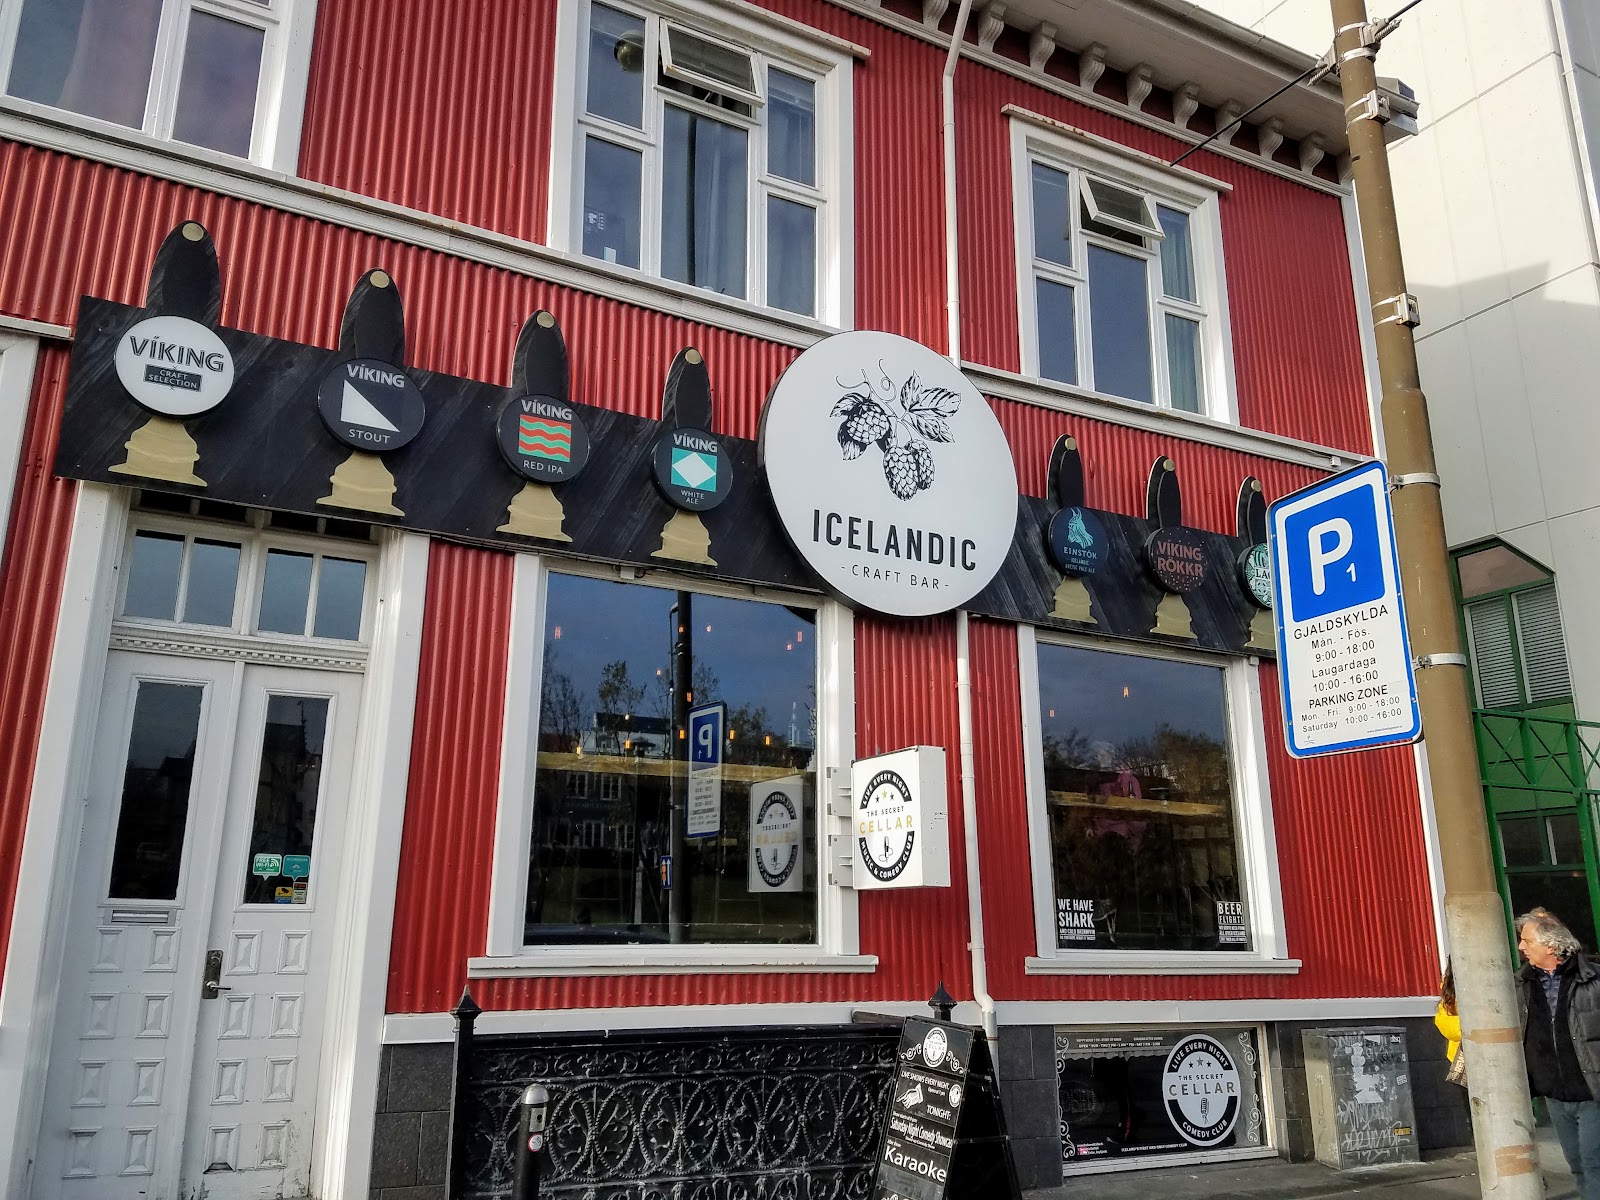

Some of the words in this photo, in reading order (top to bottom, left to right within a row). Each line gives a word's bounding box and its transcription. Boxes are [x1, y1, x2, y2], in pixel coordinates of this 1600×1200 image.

[128, 335, 225, 373] VÍKING
[147, 373, 200, 390] SELECTION
[159, 368, 189, 381] CRAFT
[346, 363, 406, 389] VÍKING
[521, 398, 572, 421] VÍKING
[348, 428, 391, 444] STOUT
[673, 433, 718, 453] VÍKING
[523, 460, 544, 472] RED
[547, 464, 564, 475] IPA
[680, 489, 705, 500] WHITE
[686, 496, 699, 505] ALE
[812, 509, 977, 571] ICELANDIC
[1307, 517, 1354, 596] P
[1346, 563, 1357, 583] 1
[851, 564, 900, 583] CRAFT
[910, 574, 939, 590] BAR
[1293, 604, 1389, 640] GJALDSKYLDA
[1347, 627, 1371, 642] Fös.
[1315, 649, 1337, 663] 9:00
[1346, 640, 1376, 655] 18:00
[1311, 656, 1377, 679] Laugardaga
[1313, 678, 1340, 693] 10:00
[1349, 670, 1379, 686] 16:00
[1309, 691, 1355, 709] PARKING
[1357, 685, 1389, 700] ZONE
[1301, 710, 1320, 722] Mon.
[1348, 703, 1368, 715] 9:00
[1376, 696, 1400, 708] 18:00
[1302, 720, 1338, 734] Saturday
[1345, 714, 1368, 726] 10:00
[1376, 708, 1402, 720] 16:00
[862, 785, 874, 805] LIVE
[873, 773, 891, 786] EVERY
[892, 775, 909, 799] NIGHT
[867, 809, 878, 817] THE
[881, 806, 905, 816] SECRET
[860, 815, 913, 835] CELLAR
[879, 862, 903, 878] COMEDY
[902, 835, 913, 861] CLUB
[1057, 898, 1072, 911] WE
[1073, 899, 1095, 911] HAVE
[1218, 903, 1243, 915] BEER
[1058, 911, 1095, 928] SHARK
[1219, 915, 1244, 924] FLIGHT!
[1171, 1050, 1185, 1069] LIVE
[1185, 1041, 1208, 1053] EVERY
[1208, 1045, 1230, 1068] NIGHT
[1168, 1081, 1236, 1097] CELLAR
[1182, 1121, 1211, 1138] COMEDY
[1211, 1119, 1228, 1136] CLUB
[884, 1145, 947, 1182] Karaoke
